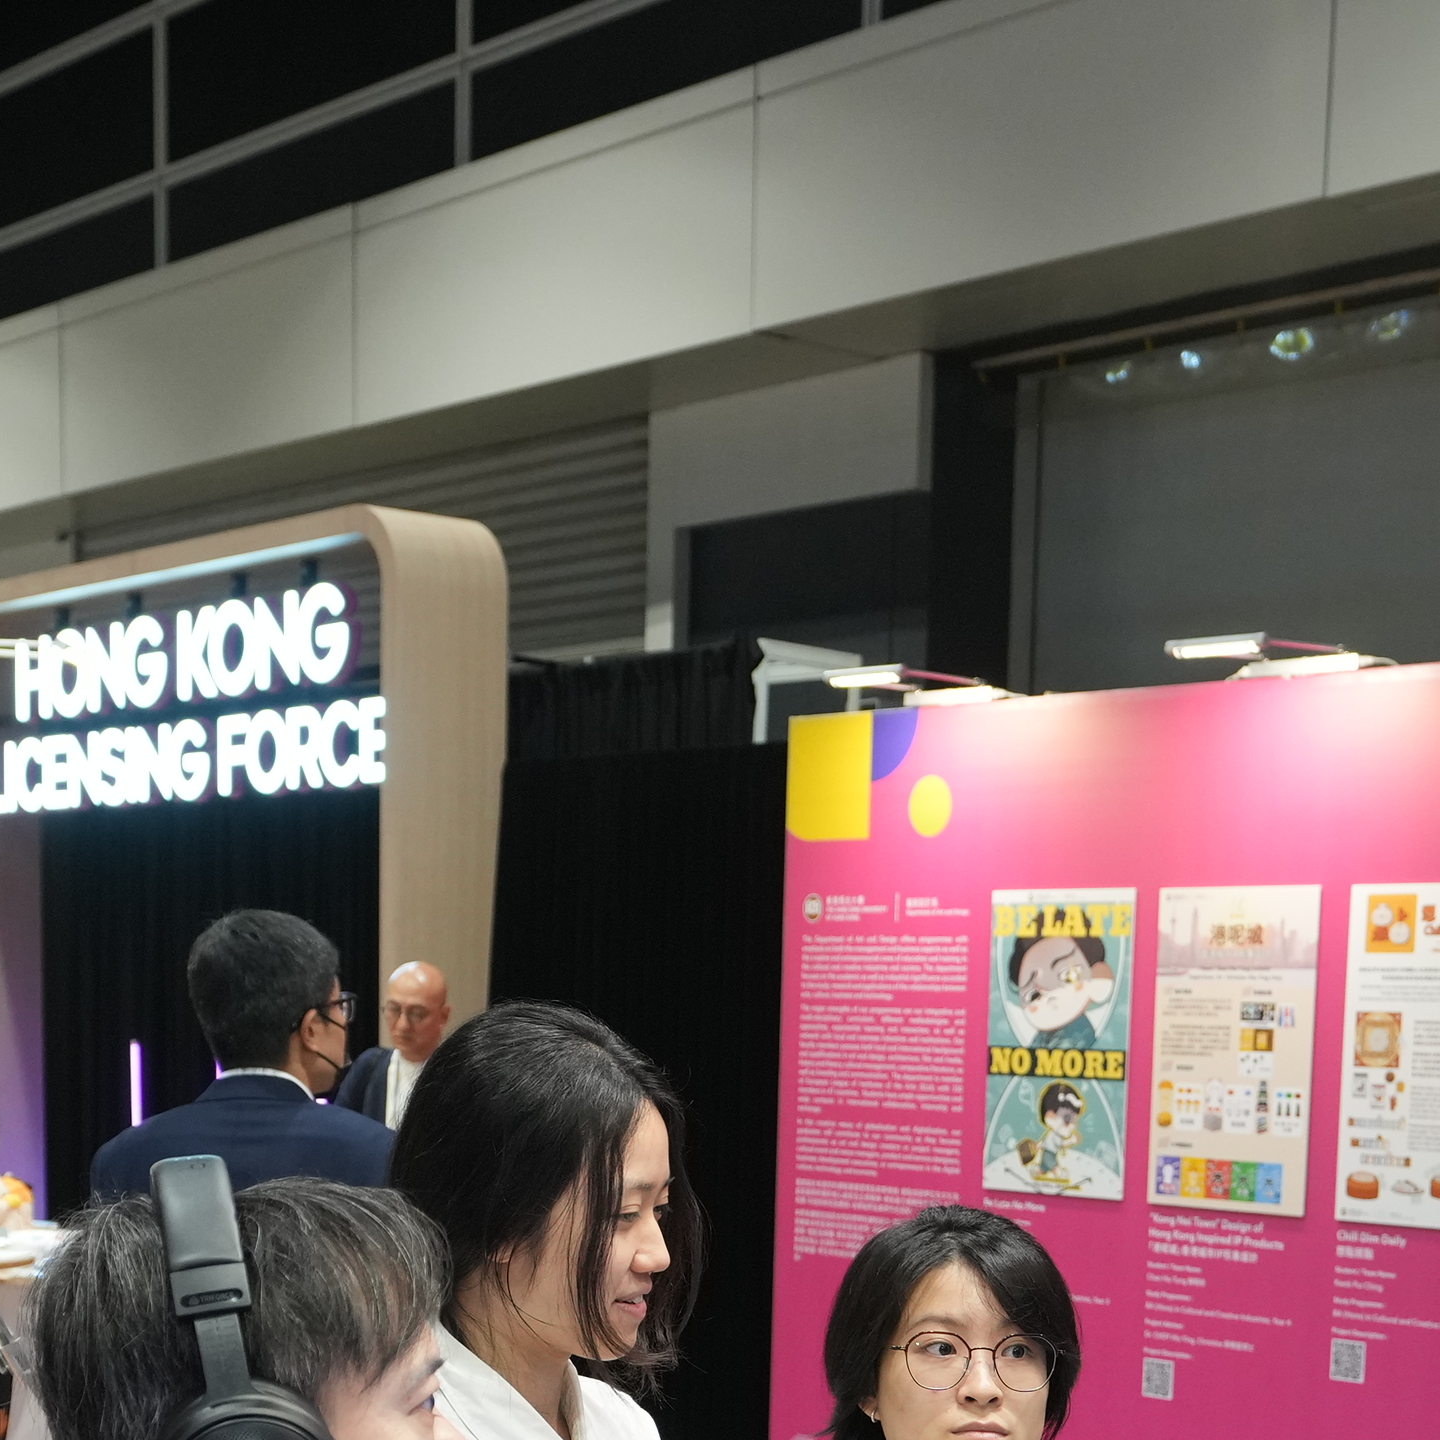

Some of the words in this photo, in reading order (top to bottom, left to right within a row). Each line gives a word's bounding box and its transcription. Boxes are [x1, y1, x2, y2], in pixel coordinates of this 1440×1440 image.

[14, 614, 169, 723] HONG
[176, 581, 352, 702] KONG
[216, 696, 387, 798] FORCE
[993, 904, 1038, 939] BE
[1041, 903, 1133, 938] LATE
[989, 1046, 1033, 1077] NO
[1034, 1048, 1125, 1080] MORE
